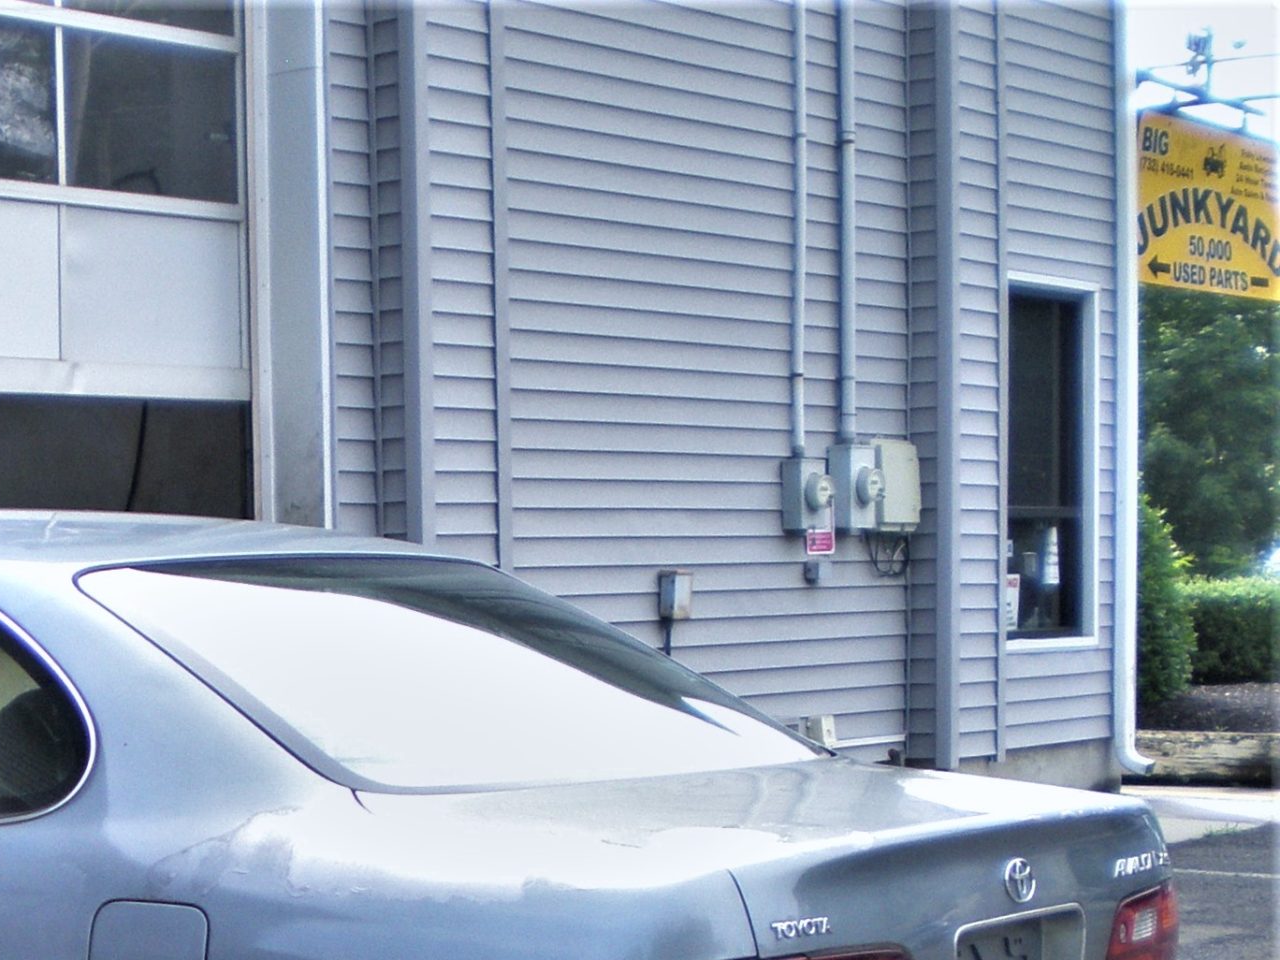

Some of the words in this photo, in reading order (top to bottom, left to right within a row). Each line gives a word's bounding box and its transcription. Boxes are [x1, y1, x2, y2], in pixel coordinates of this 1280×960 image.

[1141, 126, 1169, 156] BIG
[1189, 235, 1232, 262] 50,000
[1173, 261, 1206, 285] USED
[1210, 267, 1248, 291] PARTS
[771, 916, 831, 940] TOYOTA
